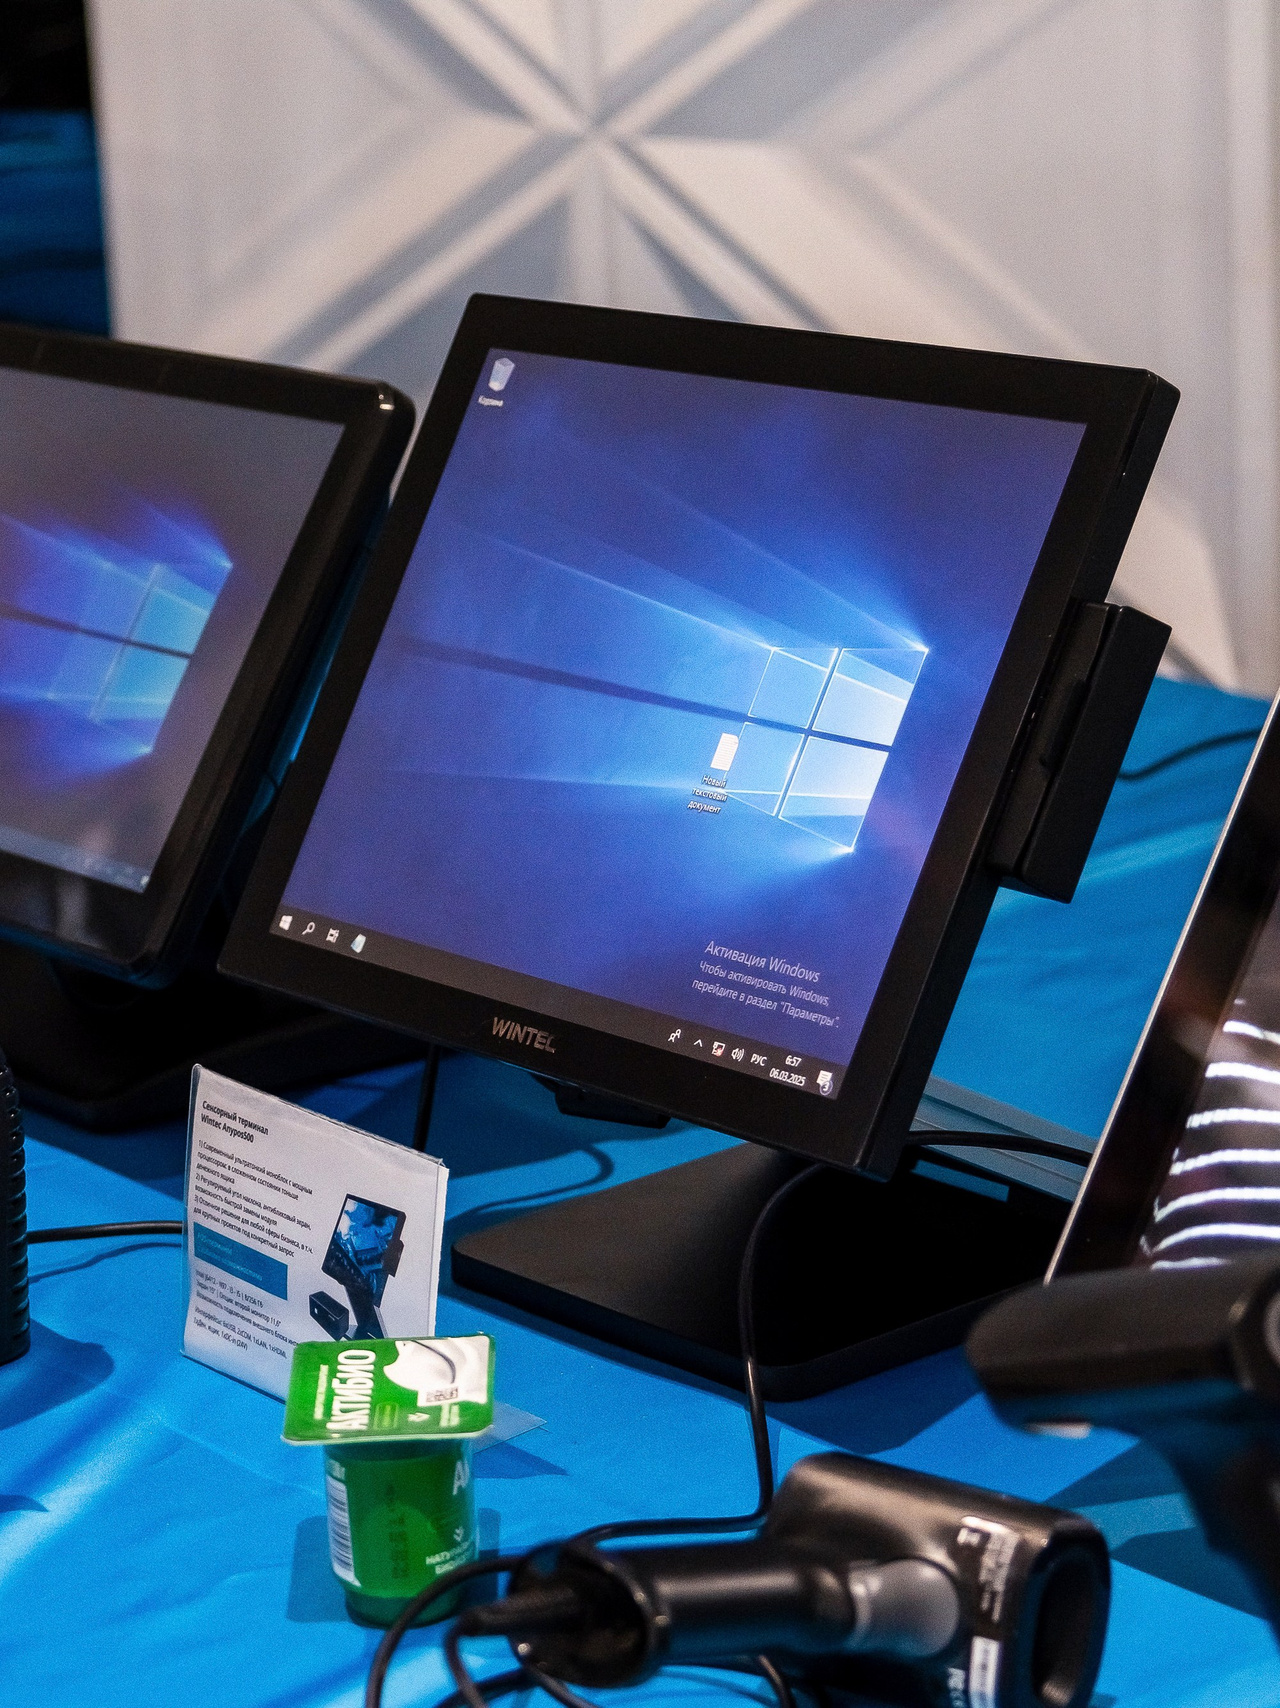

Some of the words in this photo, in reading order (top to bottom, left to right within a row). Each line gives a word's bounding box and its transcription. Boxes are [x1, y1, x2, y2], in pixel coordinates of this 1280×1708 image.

[692, 788, 728, 802] текстовый
[702, 775, 727, 788] Новый
[687, 800, 721, 814] документ
[704, 941, 766, 968] Активация
[769, 956, 820, 983] Windows
[700, 961, 727, 978] Чтобы
[728, 970, 787, 994] активировать
[789, 985, 829, 1007] Windows,
[692, 979, 737, 1000] перейдите
[745, 995, 777, 1011] раздел
[780, 1001, 840, 1028] "Параметры".
[492, 1016, 559, 1054] WINTEC
[750, 1053, 767, 1066] РУС
[785, 1055, 802, 1067] 6:57
[769, 1067, 806, 1087] 06.03.2025
[201, 1113, 222, 1130] Wintec
[222, 1123, 254, 1143] Anypos500
[202, 1100, 237, 1122] Сенсорный
[238, 1116, 269, 1135] терминал
[326, 1349, 376, 1430] АКТИБИО
